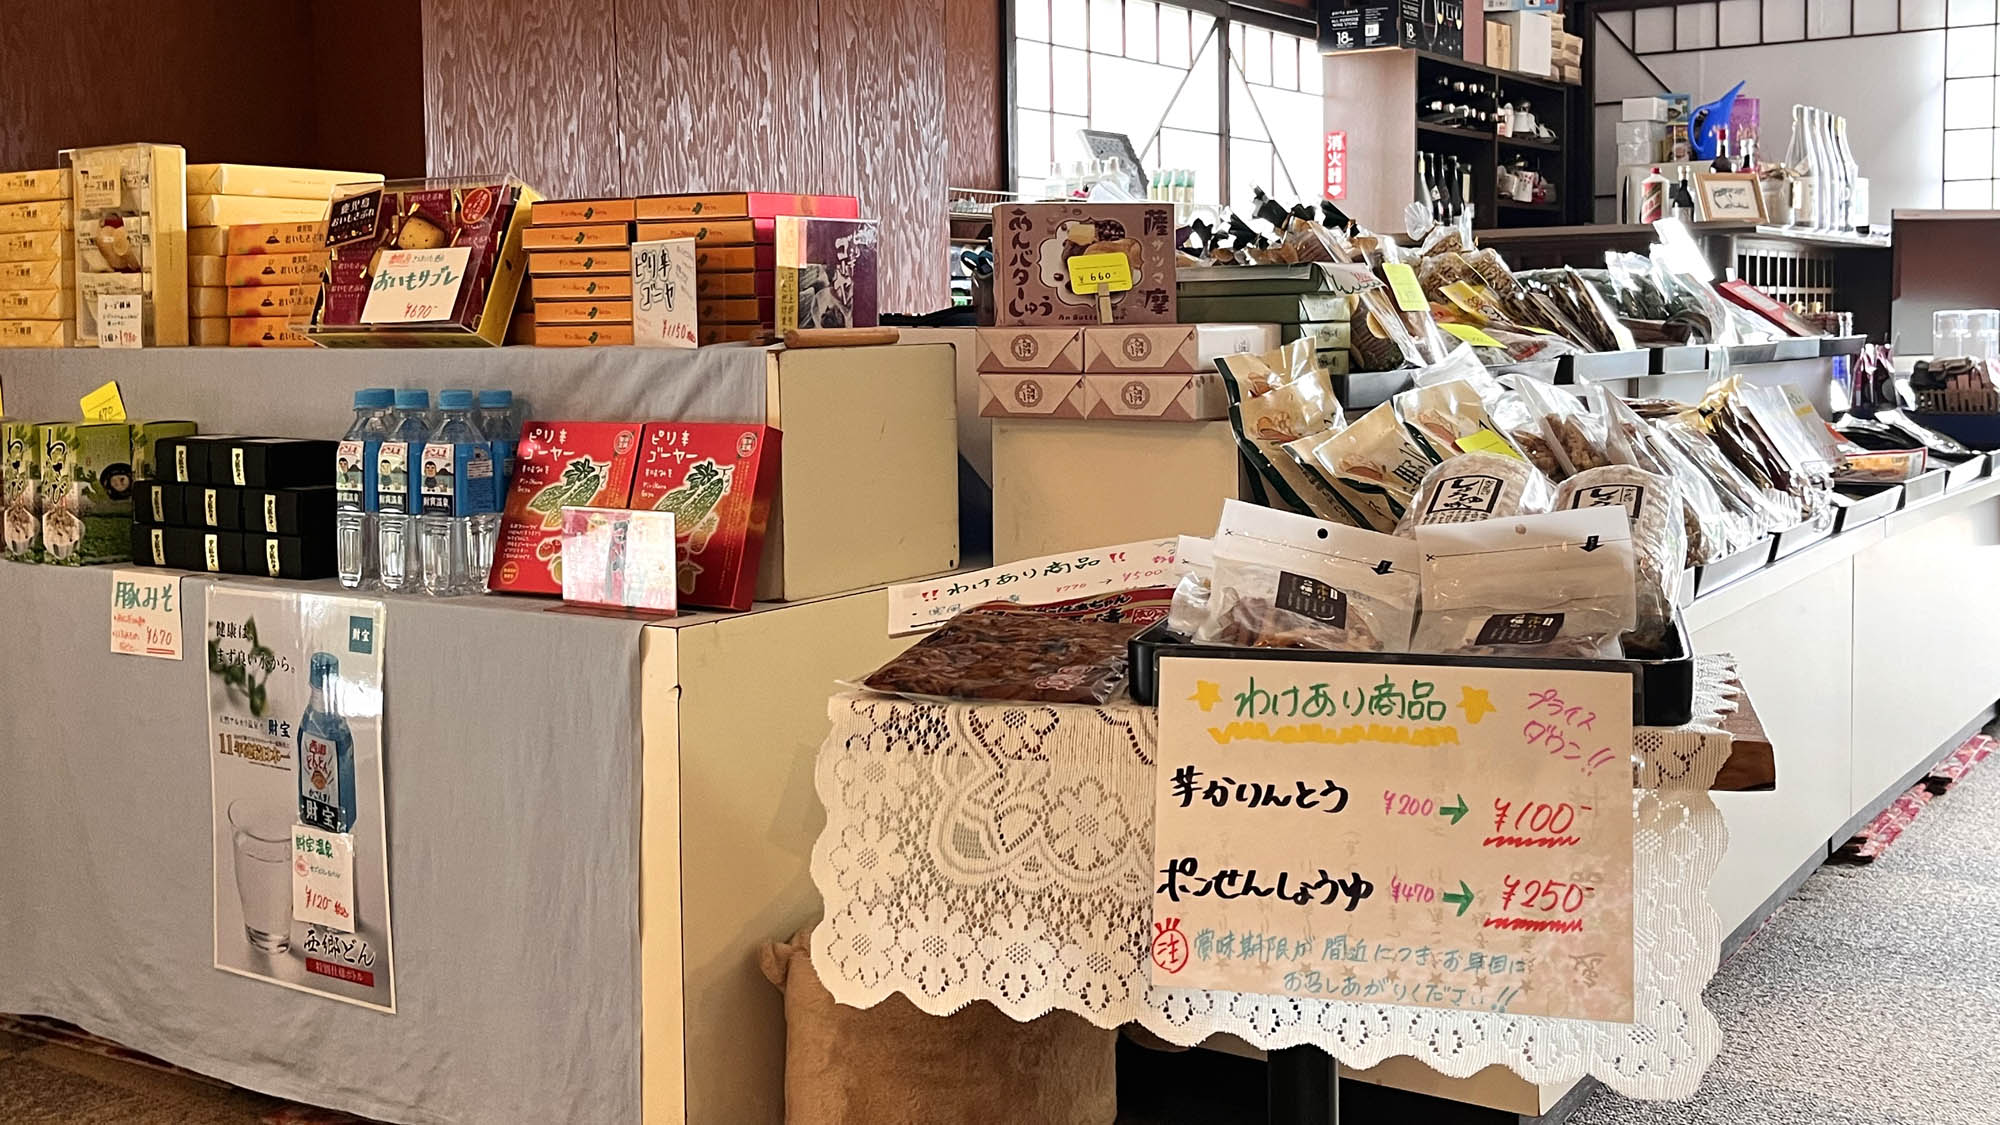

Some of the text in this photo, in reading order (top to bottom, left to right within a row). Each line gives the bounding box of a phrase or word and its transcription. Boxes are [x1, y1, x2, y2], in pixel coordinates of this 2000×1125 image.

[1336, 31, 1349, 44] 18
[523, 444, 576, 462] ゴーヤー
[646, 446, 699, 465] ゴーヤー
[114, 581, 173, 613] 豚みそ
[1233, 673, 1447, 722] わけあり商品
[1170, 764, 1350, 814] 芋かりんとう
[1383, 790, 1434, 818] ¥200
[1156, 856, 1375, 912] ポンせんしょうゆ
[1391, 875, 1434, 904] ¥470
[303, 929, 376, 967] 西郷どん
